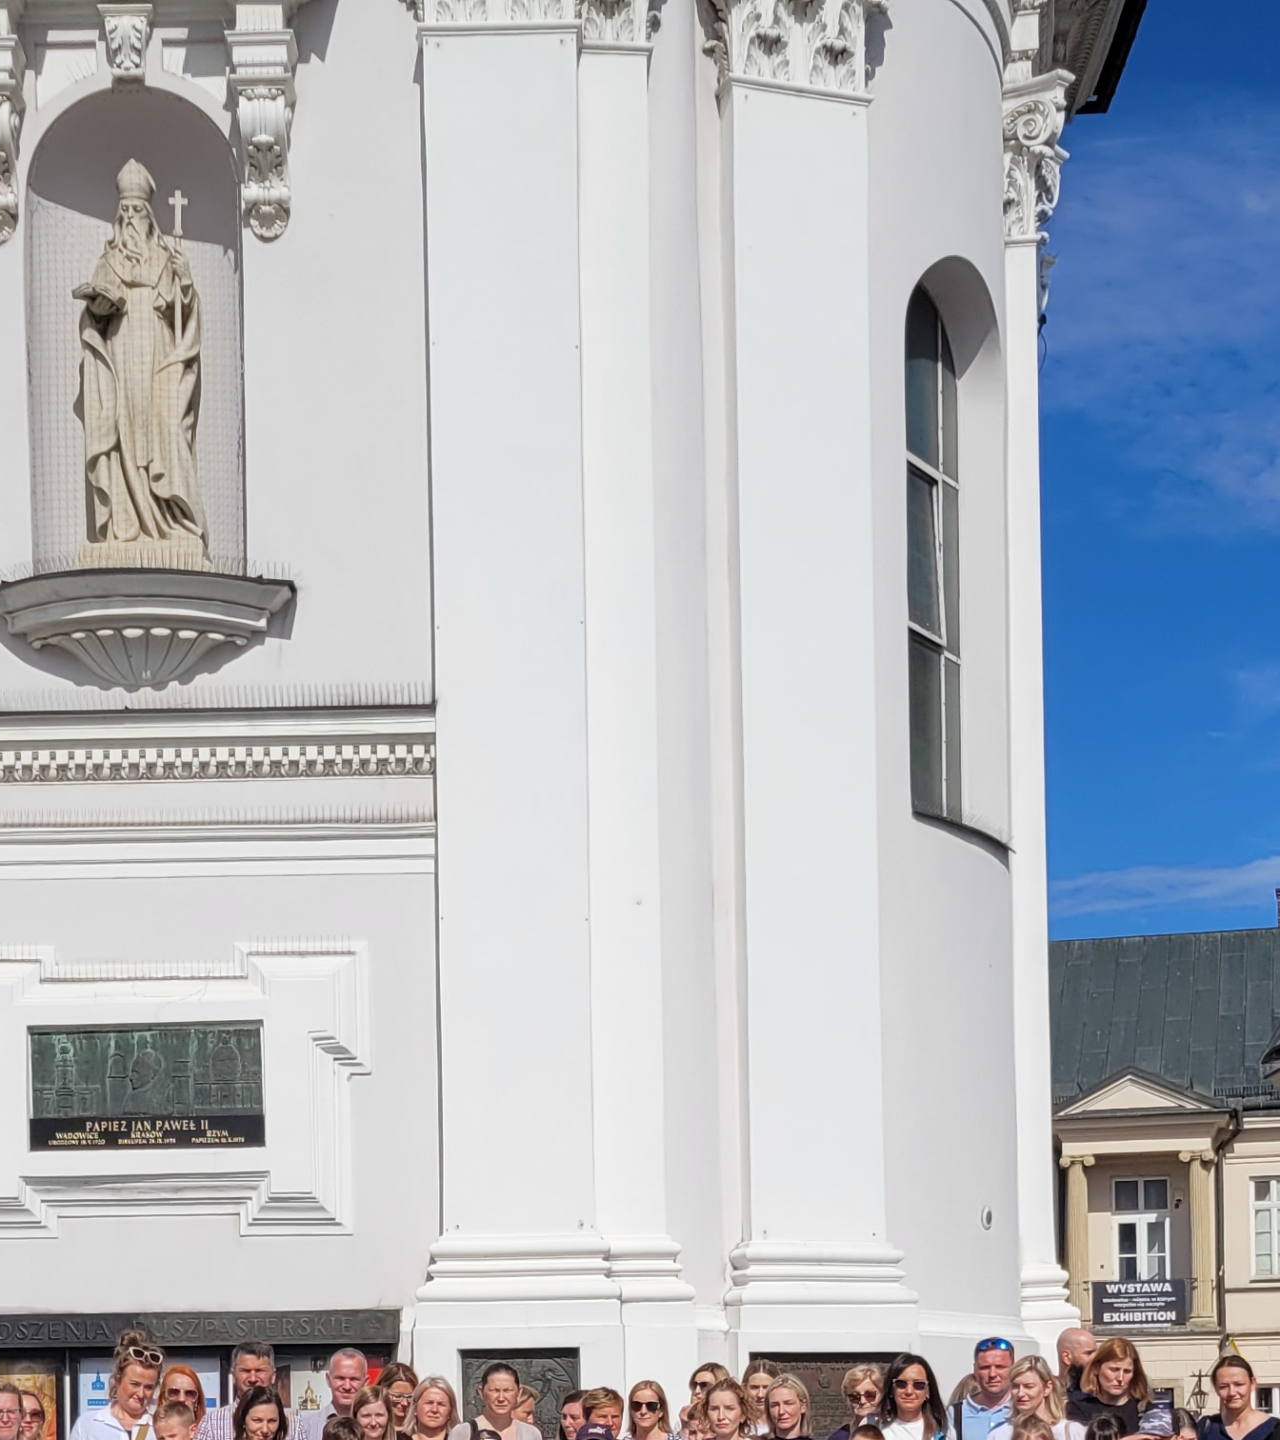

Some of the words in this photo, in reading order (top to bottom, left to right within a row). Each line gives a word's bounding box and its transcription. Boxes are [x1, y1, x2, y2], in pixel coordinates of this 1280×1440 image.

[131, 1120, 152, 1132] JAN
[155, 1119, 197, 1131] PAWEŁ
[55, 1131, 100, 1140] WADOWICE
[1105, 1282, 1173, 1294] WYSTAWA
[1103, 1310, 1176, 1322] EXHIBITION
[131, 1316, 355, 1340] DUSZPASTERSKIE
